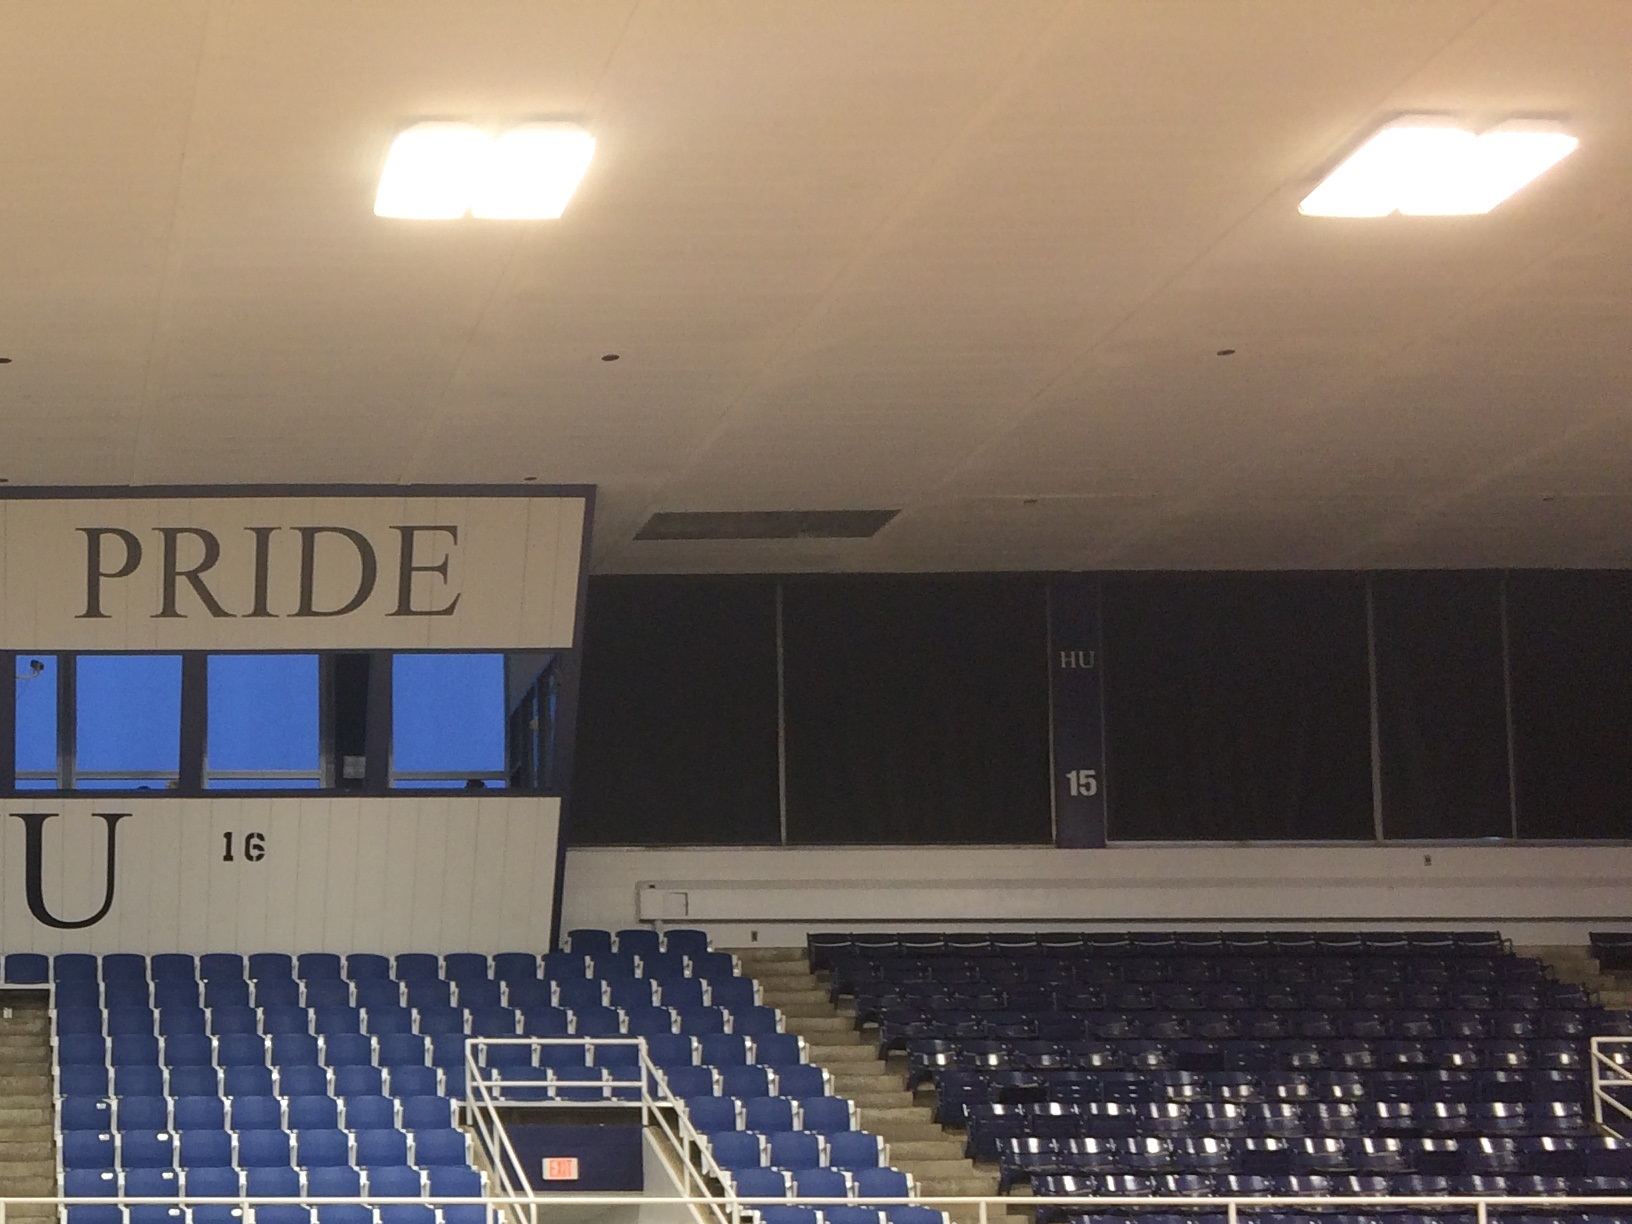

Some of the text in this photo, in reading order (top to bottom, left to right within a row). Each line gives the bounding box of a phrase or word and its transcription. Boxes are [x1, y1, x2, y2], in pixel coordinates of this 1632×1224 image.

[74, 524, 462, 619] PRIDE
[1060, 651, 1095, 668] HU
[1066, 769, 1097, 796] 15
[223, 831, 266, 862] 16
[549, 1159, 572, 1177] EXIT
